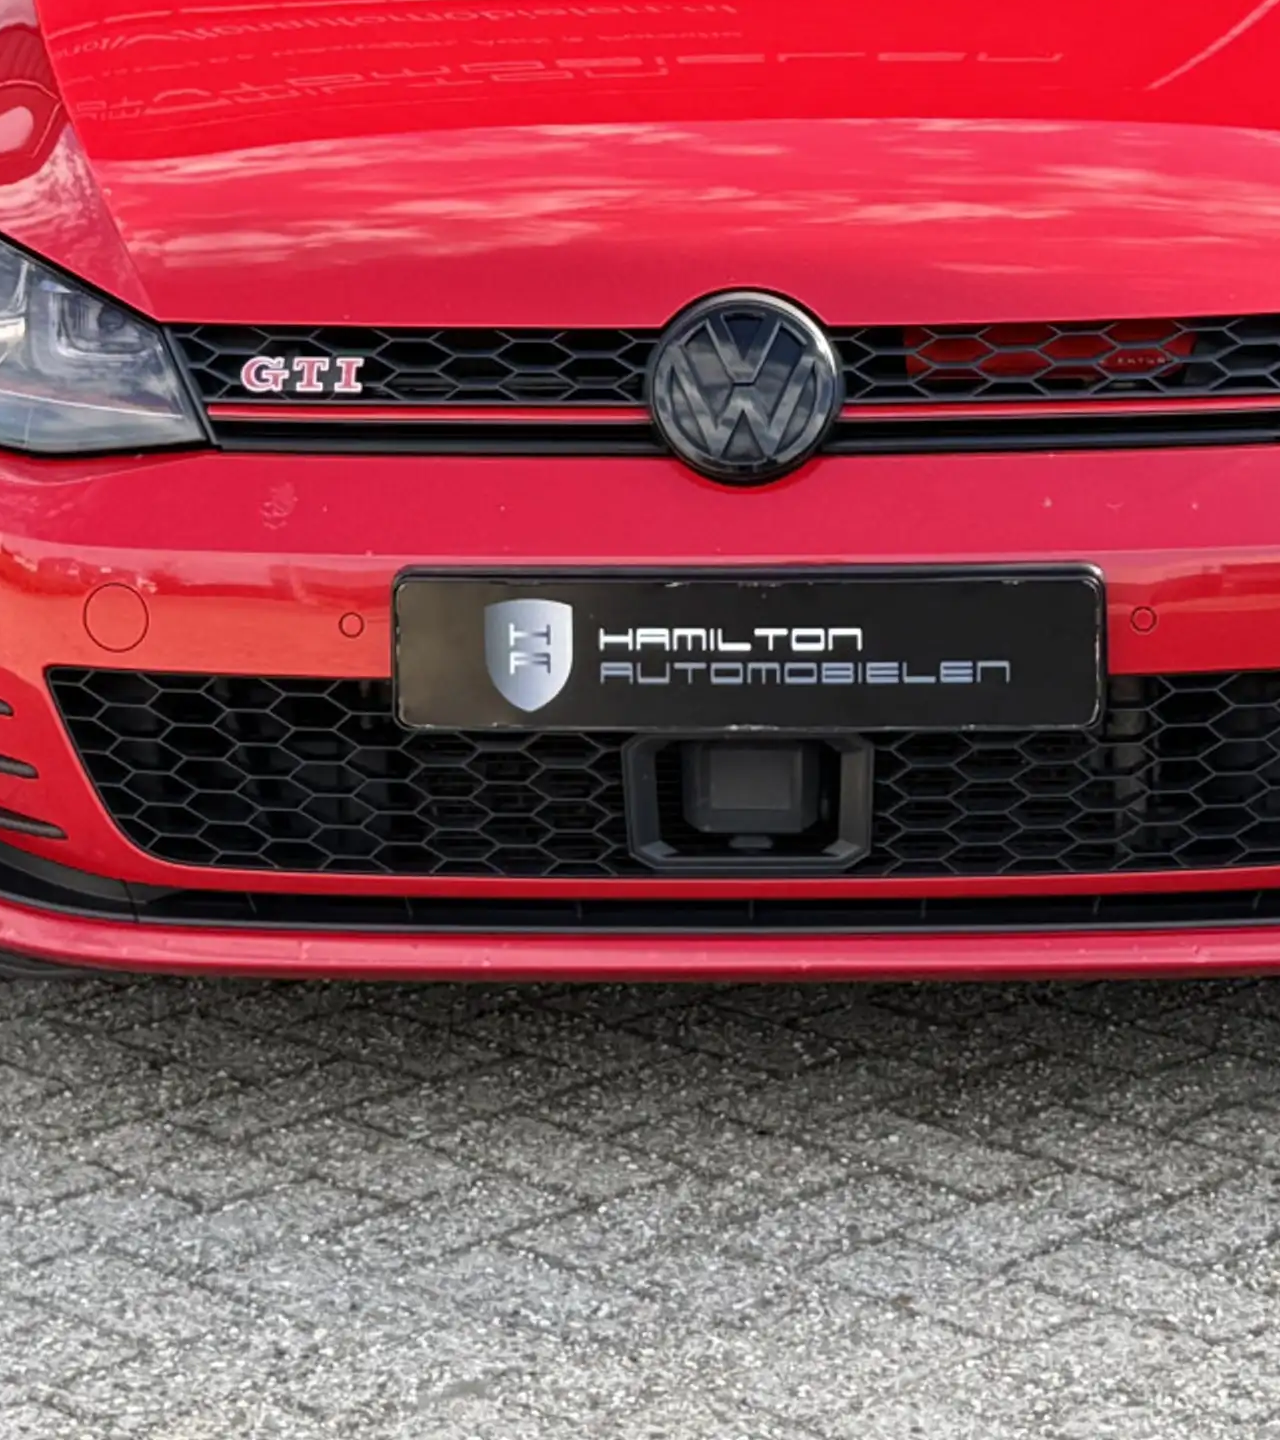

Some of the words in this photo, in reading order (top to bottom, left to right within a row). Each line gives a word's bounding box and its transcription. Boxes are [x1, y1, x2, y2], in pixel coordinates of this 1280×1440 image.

[240, 356, 365, 393] GTI
[598, 627, 863, 652] HAMILTON
[600, 660, 1011, 685] AUTOMOBIELEN
